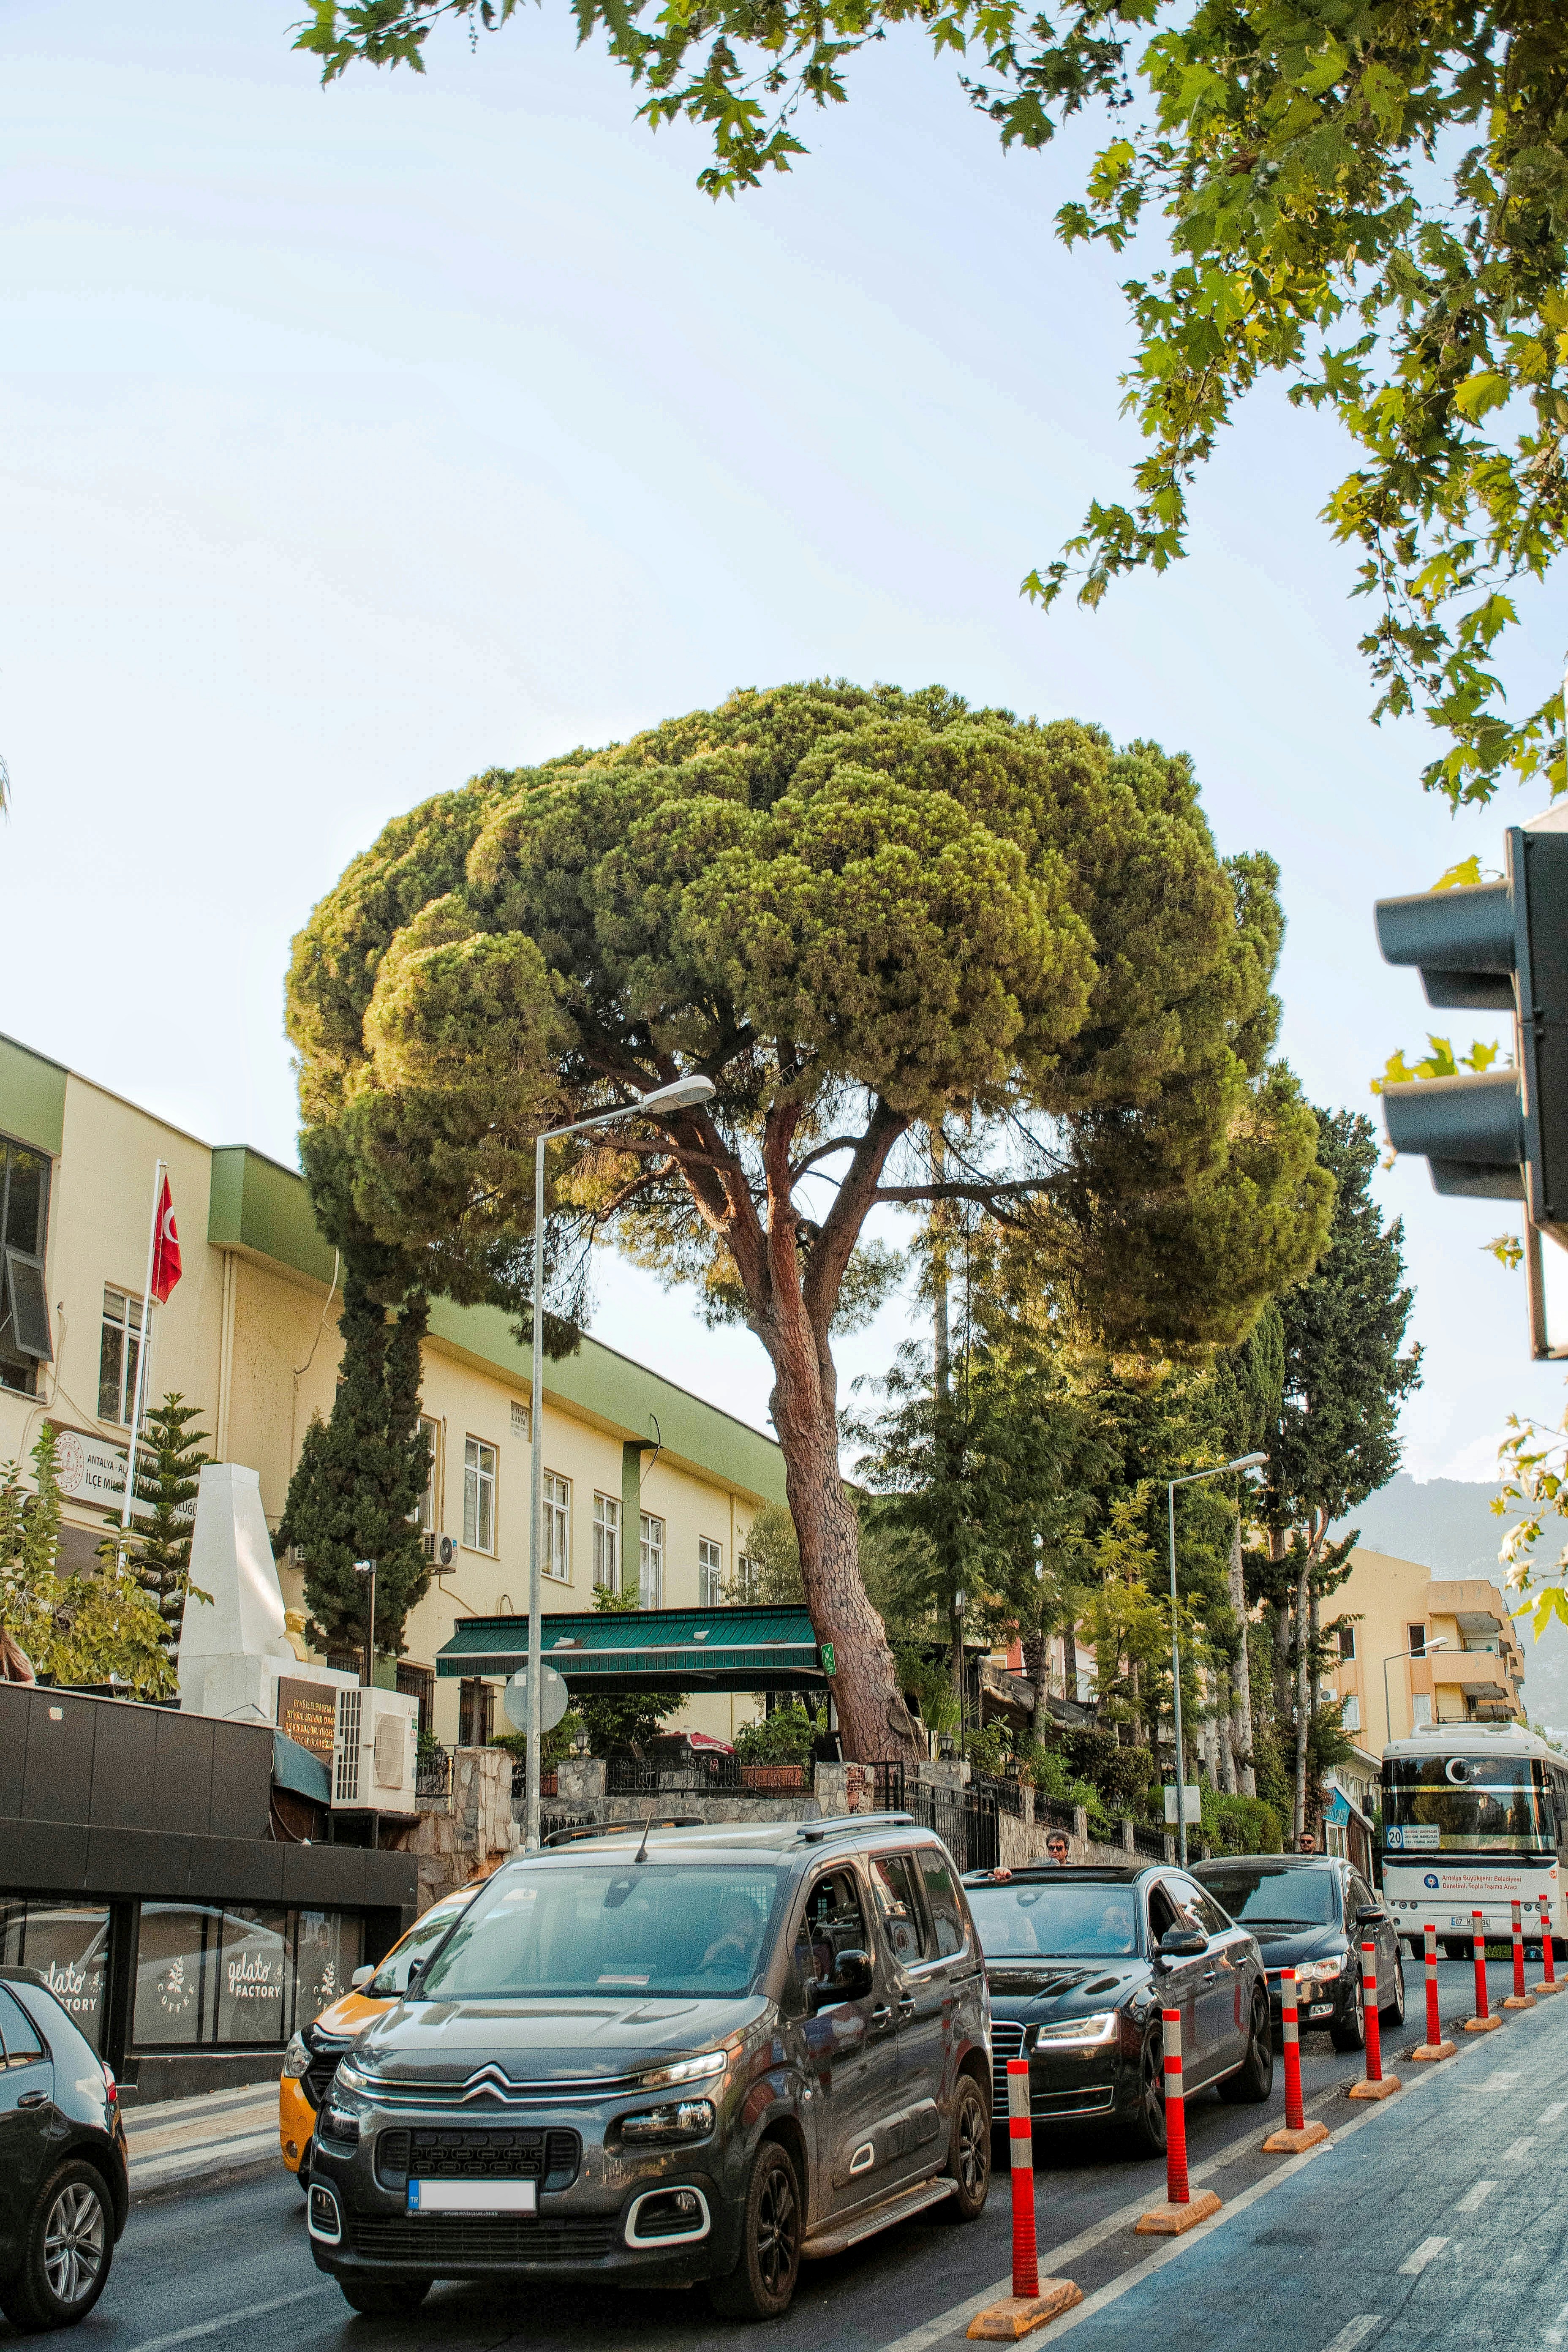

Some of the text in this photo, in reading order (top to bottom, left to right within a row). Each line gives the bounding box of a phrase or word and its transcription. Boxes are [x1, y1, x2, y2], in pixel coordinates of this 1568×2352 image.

[87, 1454, 114, 1470] ANTALYA
[86, 1469, 102, 1489] İLÇE
[1389, 1832, 1401, 1843] 20
[44, 1960, 87, 1994] elato
[228, 1952, 272, 1993] gelato
[236, 1985, 281, 1998] FACTORY
[62, 1998, 97, 2011] TORY
